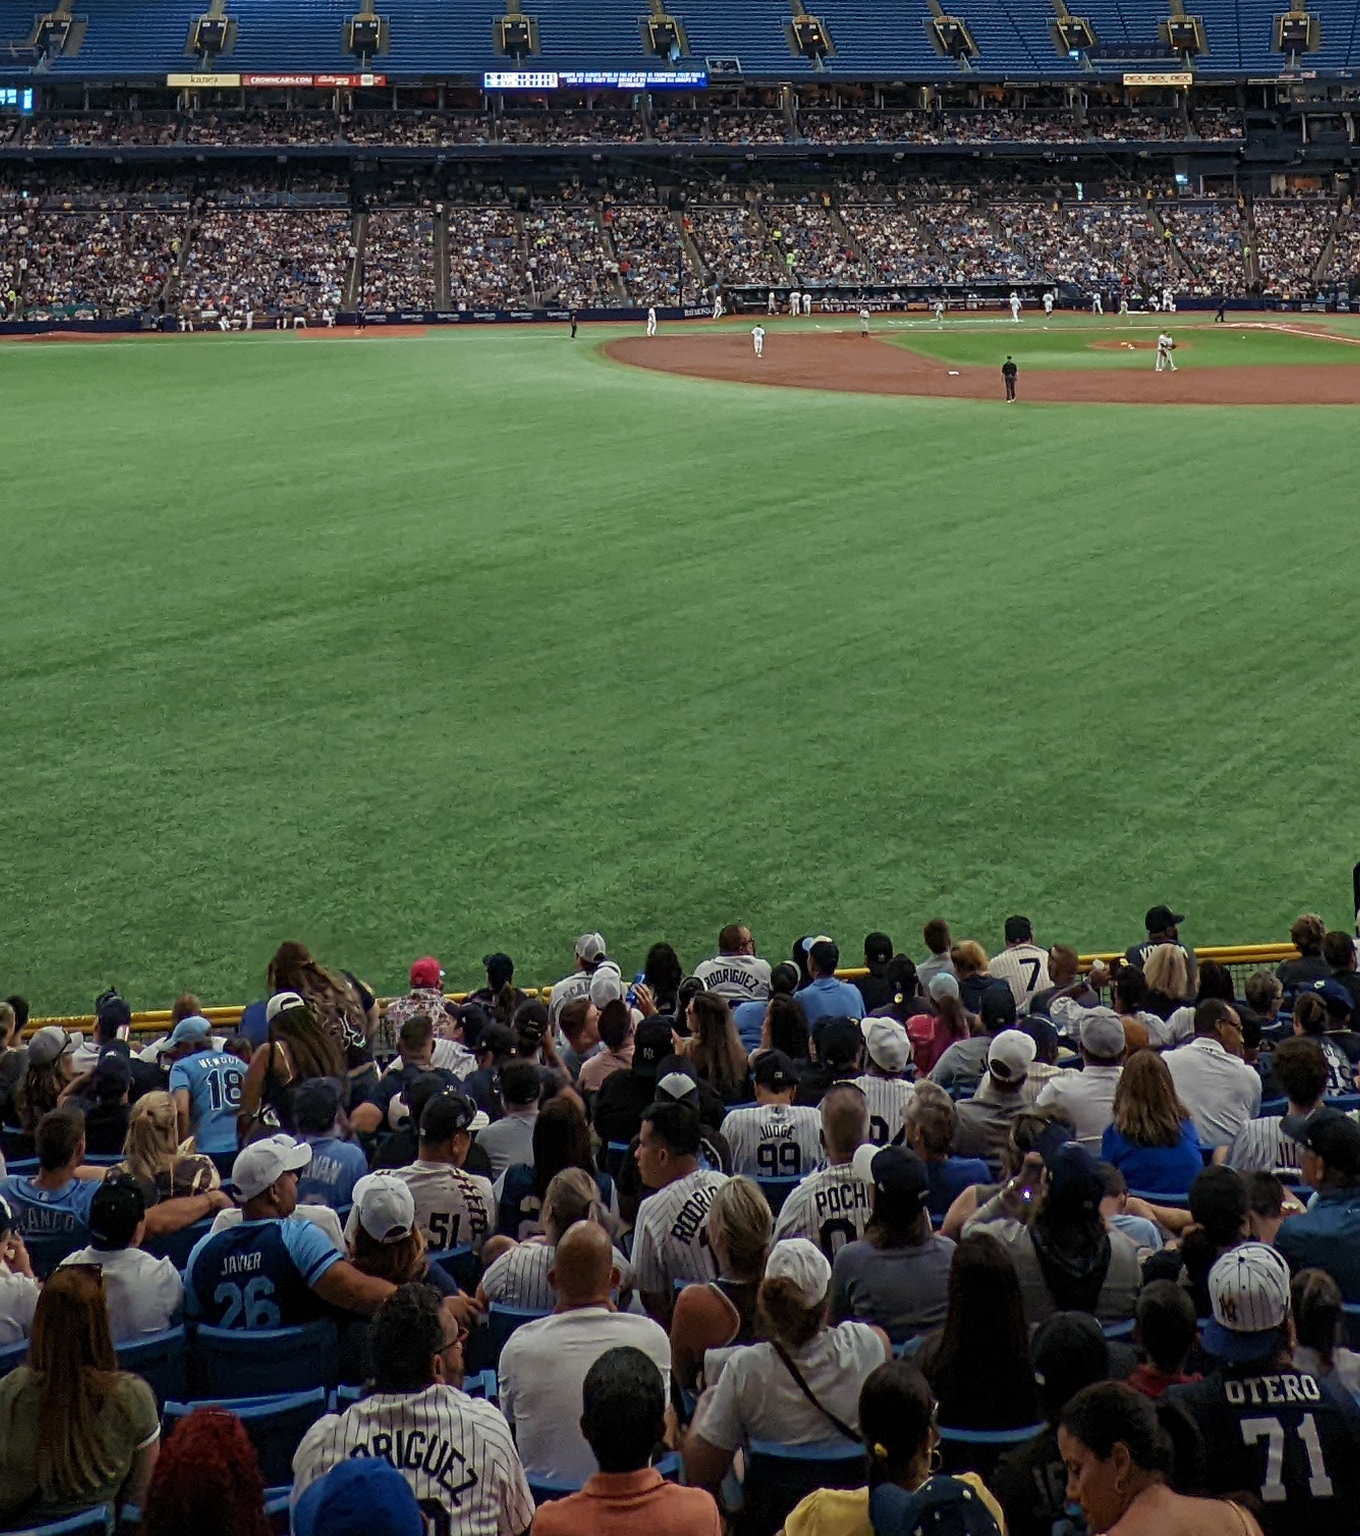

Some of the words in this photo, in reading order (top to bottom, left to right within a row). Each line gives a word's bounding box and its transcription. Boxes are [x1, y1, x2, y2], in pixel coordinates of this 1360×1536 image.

[705, 967, 760, 994] RODRIGUEZ
[1019, 957, 1042, 992] 7
[206, 1067, 245, 1112] 18
[759, 1123, 796, 1141] JUDGE
[756, 1141, 801, 1177] 99
[426, 1212, 463, 1252] 51
[220, 1250, 263, 1276] JAVIER
[213, 1275, 282, 1330] 26
[1225, 1373, 1323, 1405] OTERO
[1241, 1412, 1334, 1503] 71
